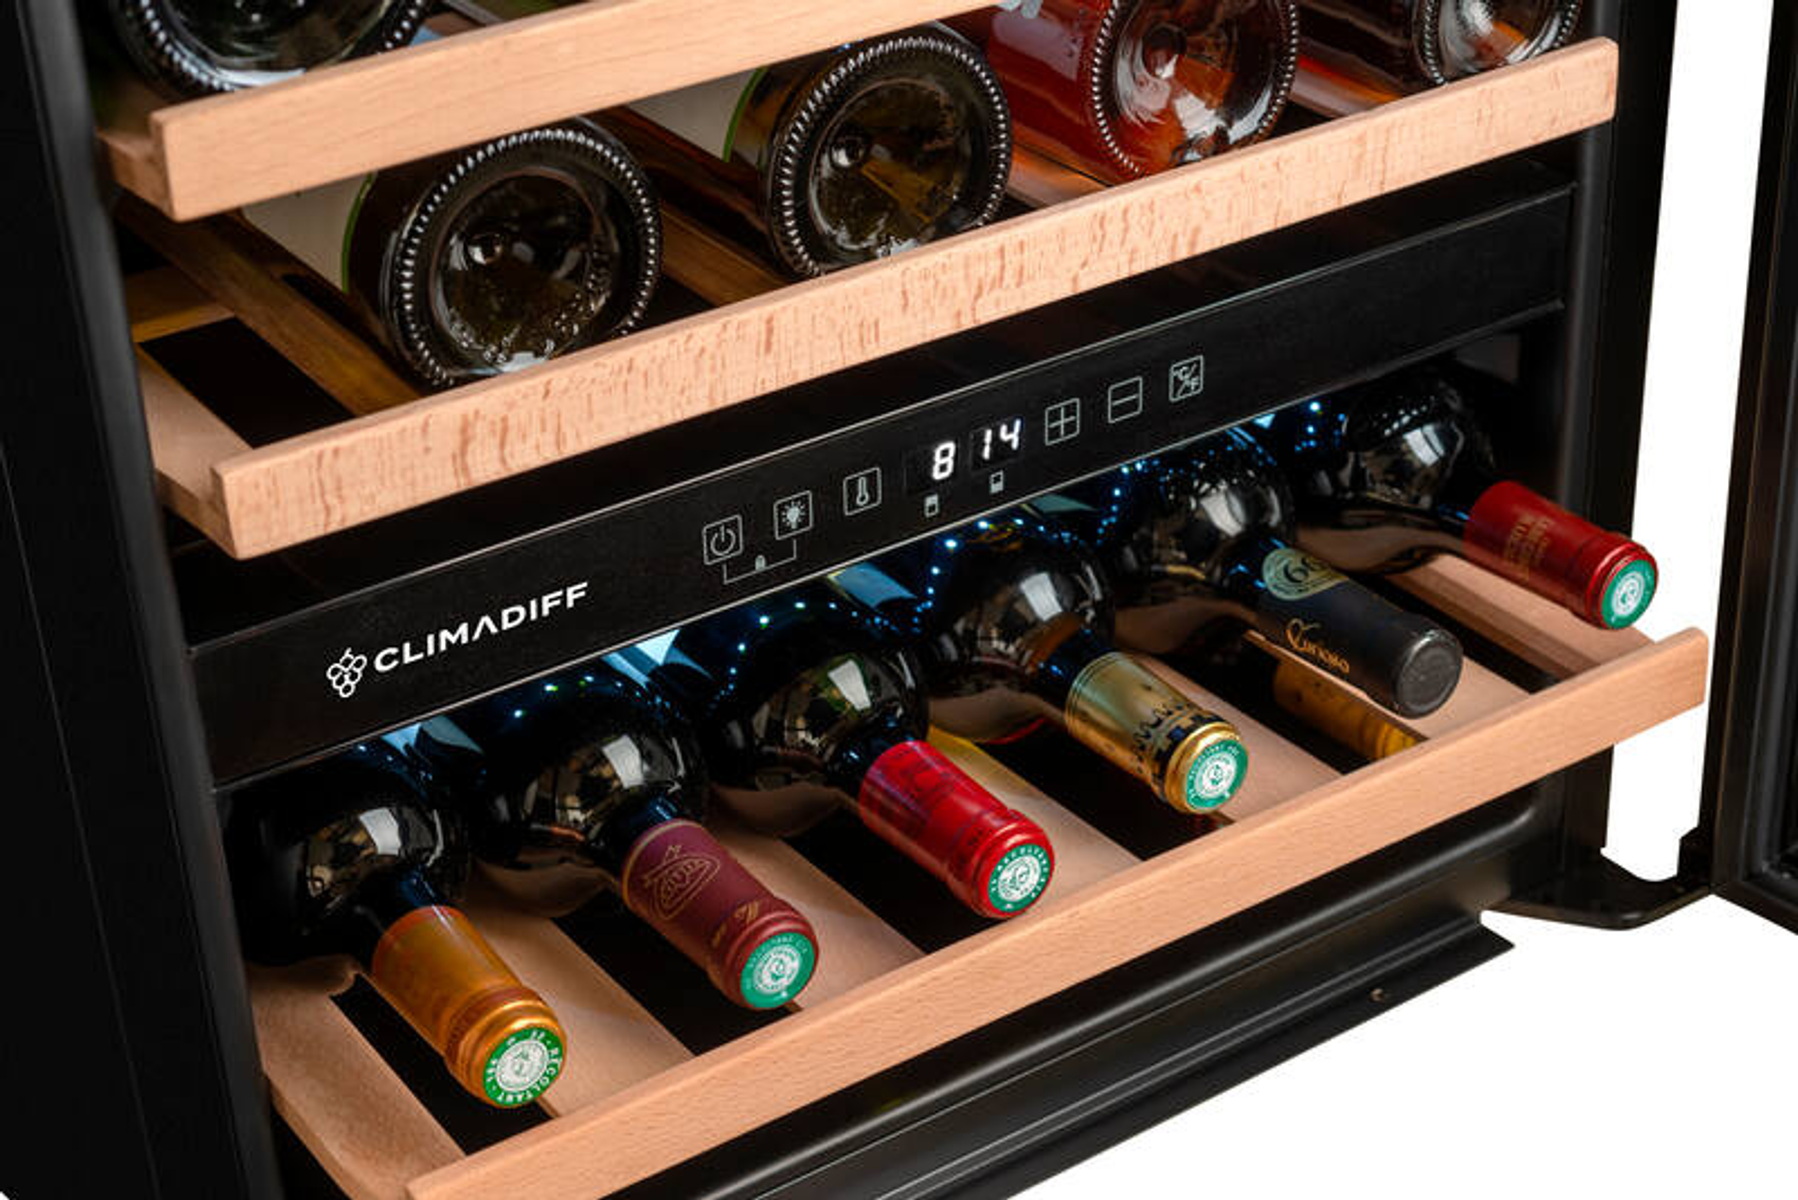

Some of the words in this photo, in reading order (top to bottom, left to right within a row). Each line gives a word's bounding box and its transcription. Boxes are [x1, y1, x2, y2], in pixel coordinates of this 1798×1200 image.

[932, 441, 956, 480] 8
[983, 419, 1021, 460] 14
[374, 581, 589, 673] CLIMADIFF
